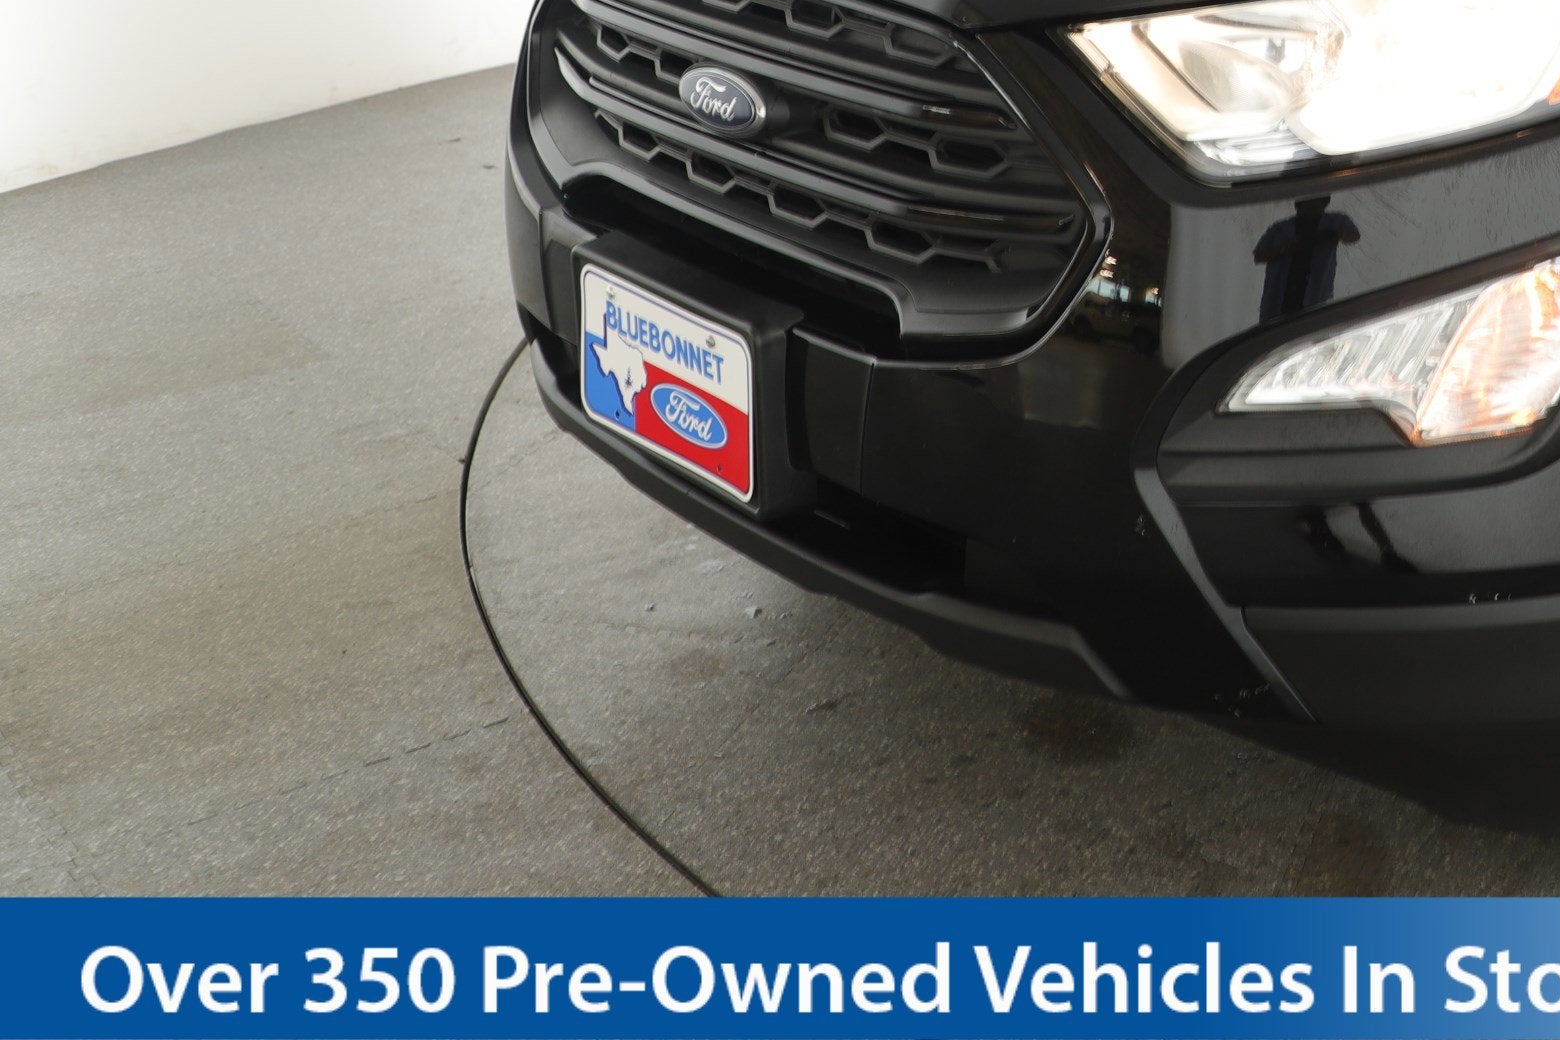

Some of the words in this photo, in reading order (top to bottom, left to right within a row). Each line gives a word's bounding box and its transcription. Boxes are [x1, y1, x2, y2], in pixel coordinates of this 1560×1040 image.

[690, 76, 737, 121] Ford
[605, 300, 725, 385] BLUEBONNET
[665, 390, 712, 442] Ford
